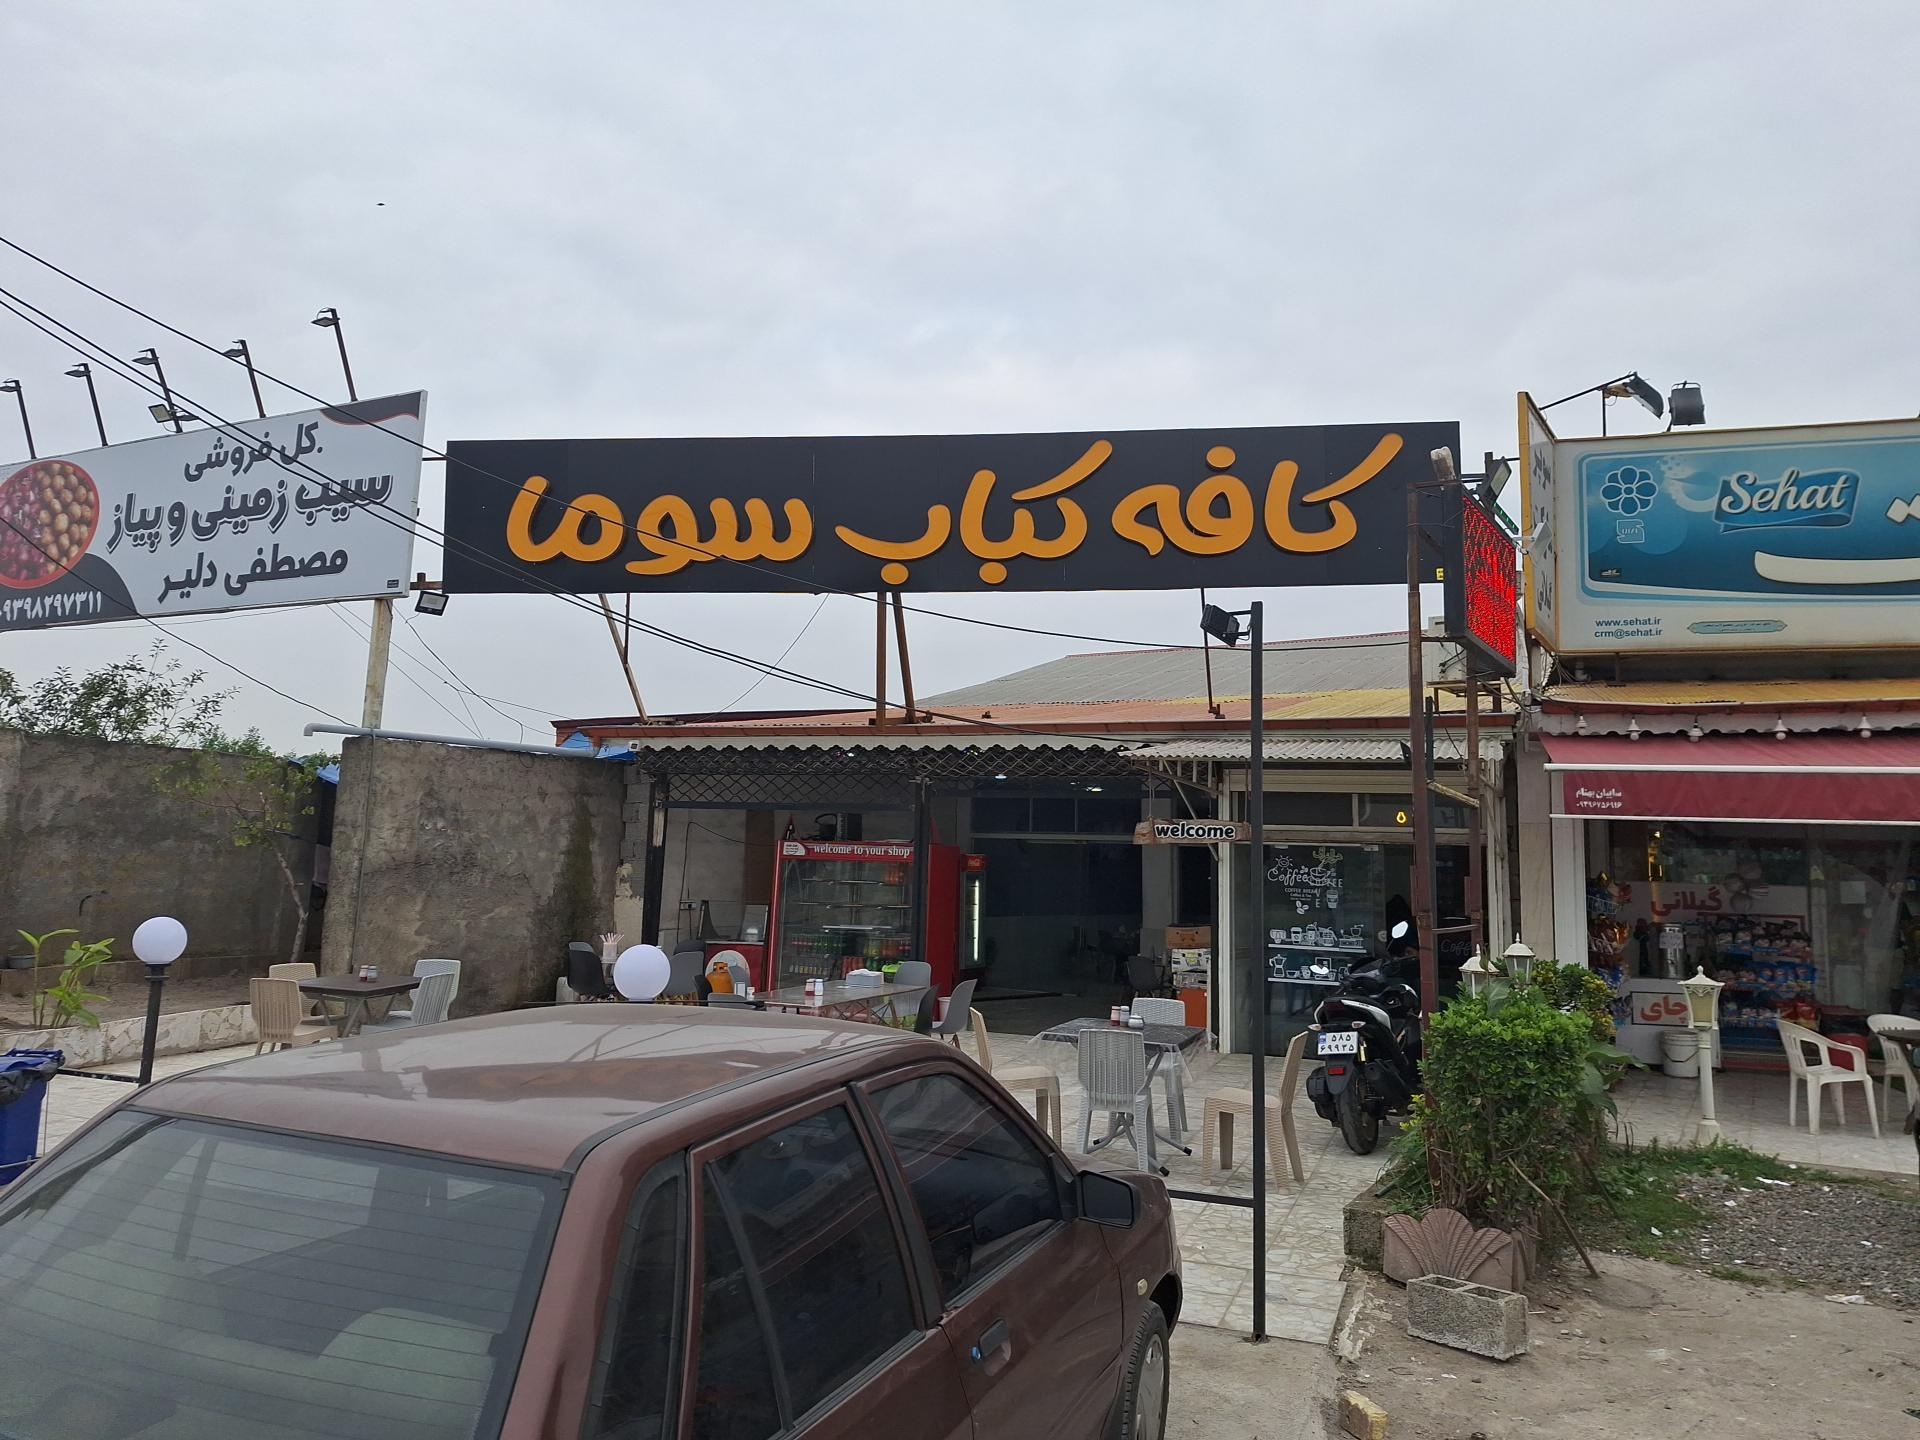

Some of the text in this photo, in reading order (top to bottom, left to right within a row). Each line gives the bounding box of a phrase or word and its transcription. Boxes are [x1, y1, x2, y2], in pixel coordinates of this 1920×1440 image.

[184, 431, 273, 482] فروشی
[1111, 433, 1404, 557] کافه
[1720, 468, 1851, 514] Sehat
[105, 474, 393, 552] سیب زمینی و پیاز
[506, 474, 814, 576] سوما
[835, 439, 1113, 585] کباب
[157, 543, 349, 604] مصطفی دلیر
[1594, 628, 1663, 639] crm@sehat.ir
[1595, 617, 1662, 627] www.sehat.ir
[1154, 822, 1236, 839] welcome
[814, 843, 852, 854] welcome
[853, 846, 863, 855] to
[865, 847, 885, 857] your
[887, 846, 910, 858] shop
[1267, 867, 1309, 886] Coffee
[1650, 886, 1722, 917] گیلانی
[1640, 996, 1689, 1024] چای
[1331, 1033, 1352, 1042] ۵۸۵
